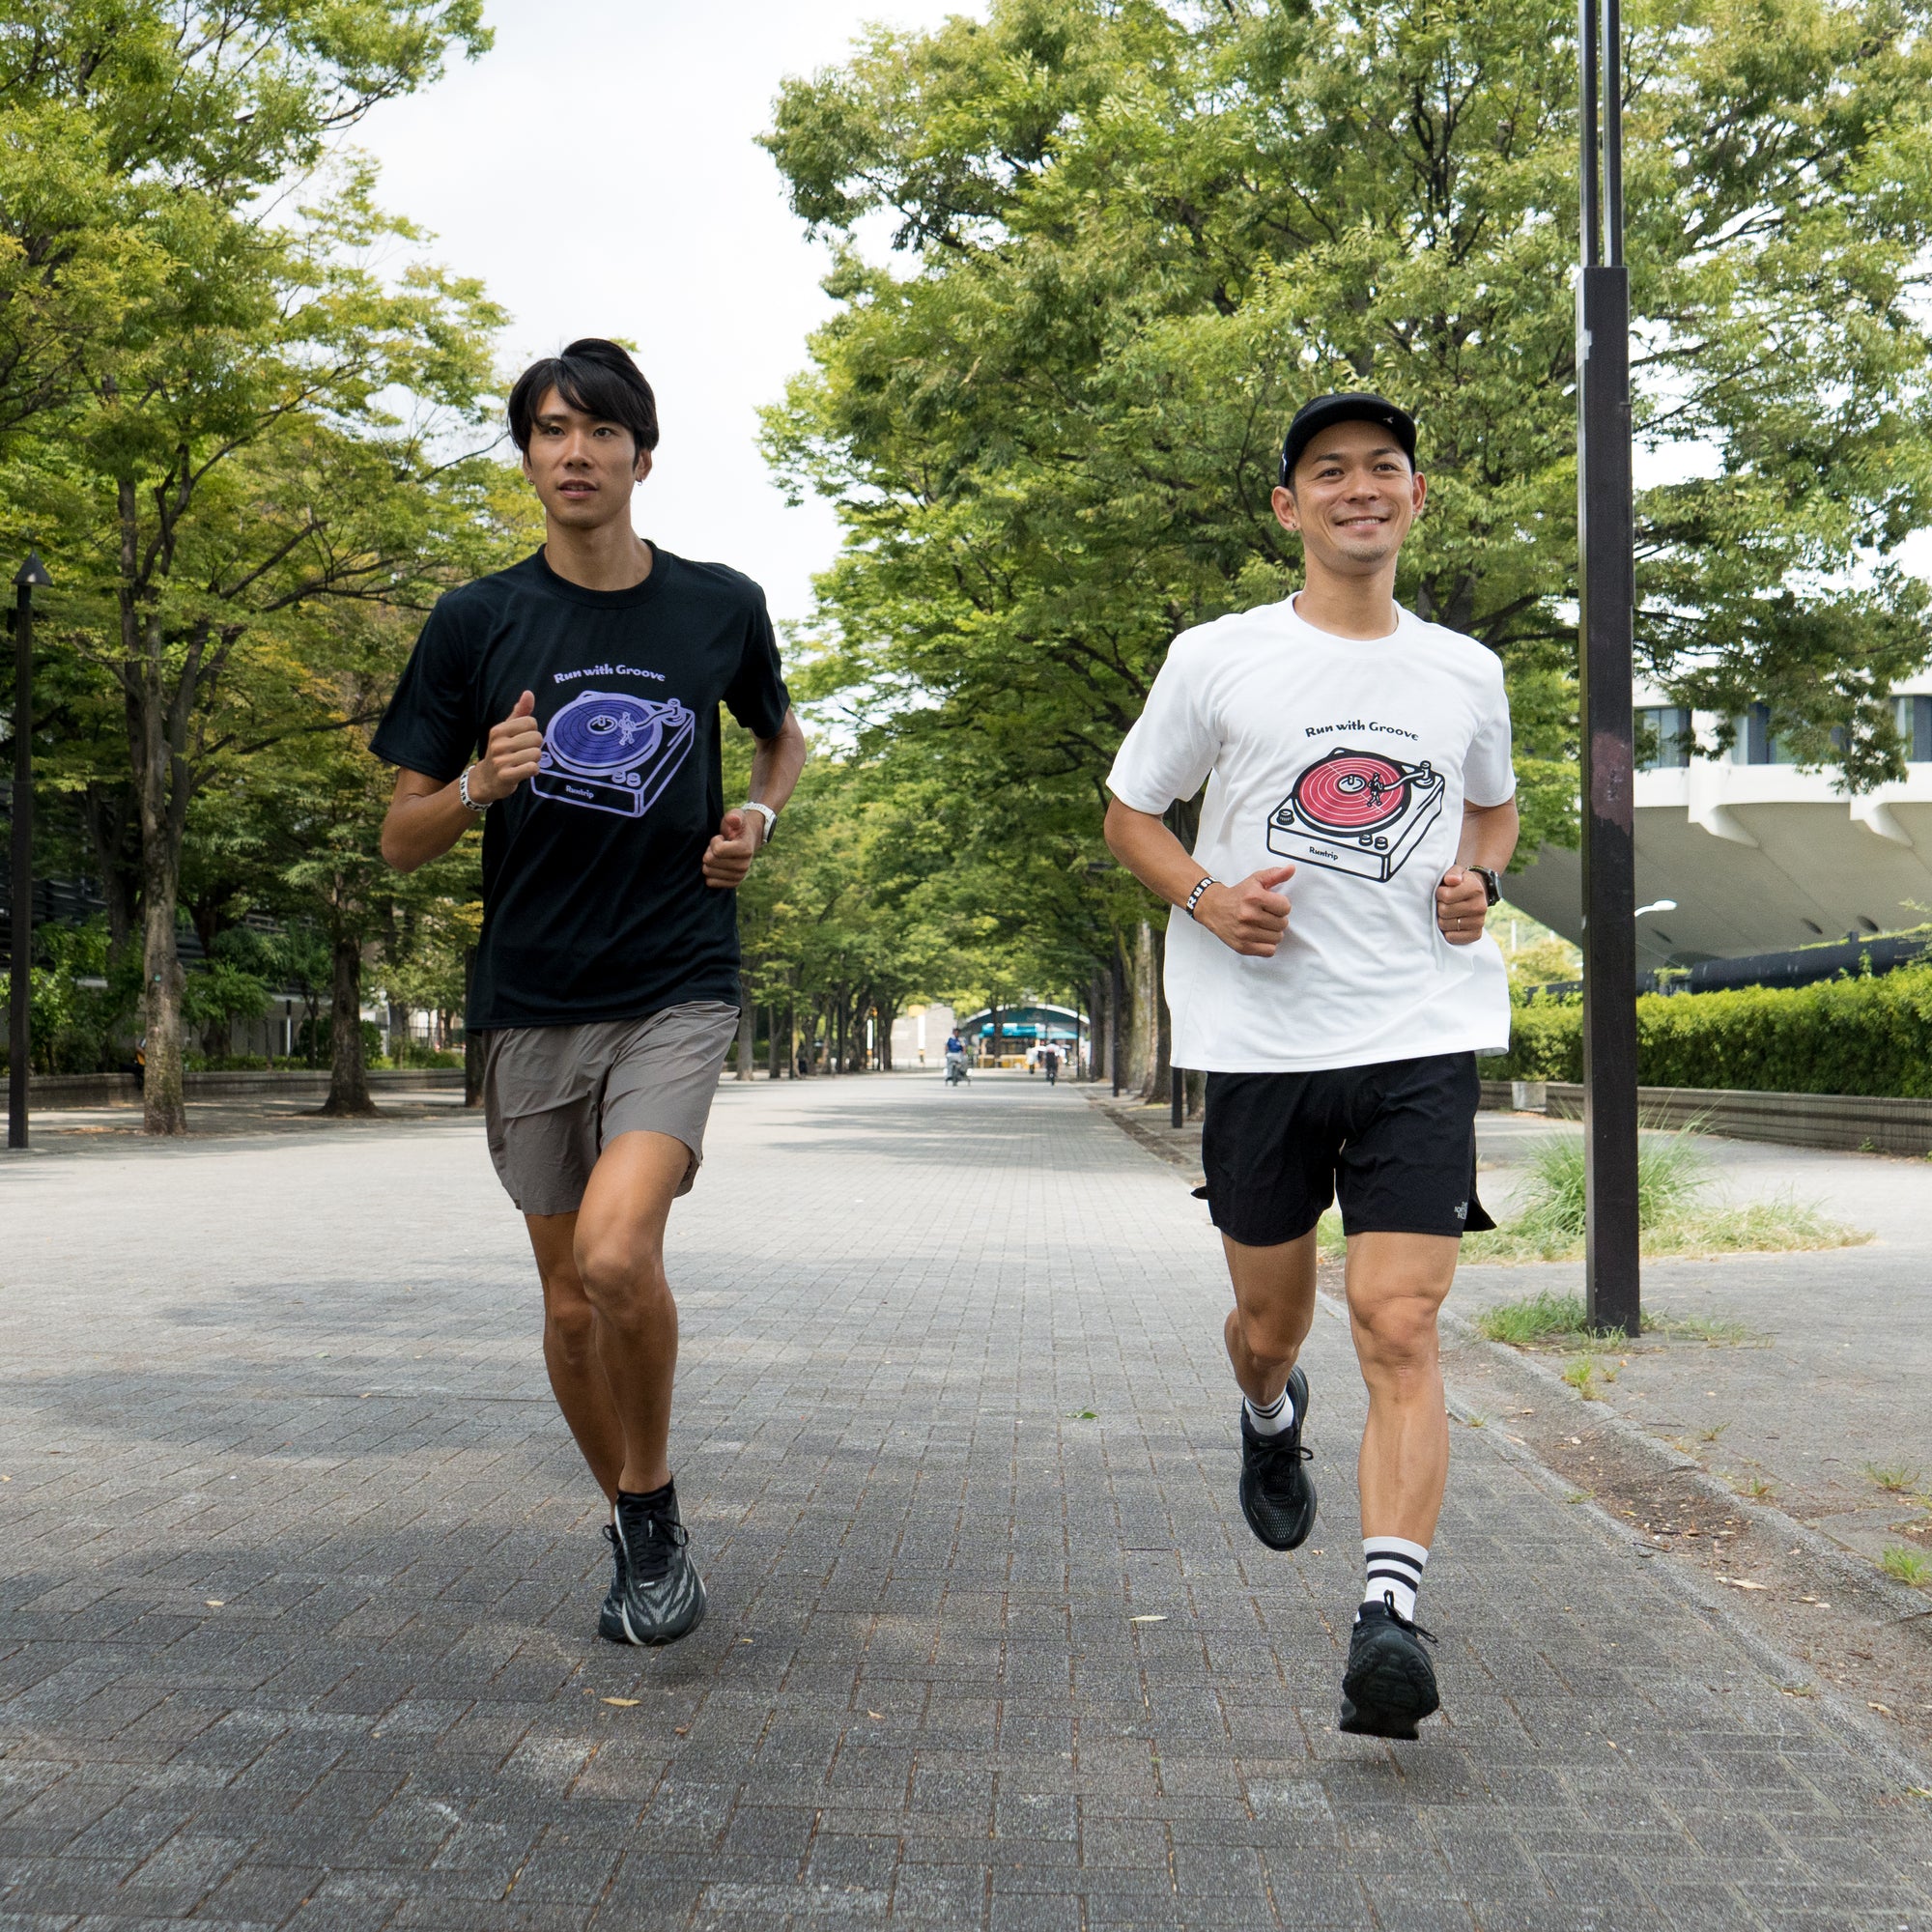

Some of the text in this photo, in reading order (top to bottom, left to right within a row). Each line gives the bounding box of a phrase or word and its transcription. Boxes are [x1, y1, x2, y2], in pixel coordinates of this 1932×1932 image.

[554, 664, 666, 684] Run with Groove
[1305, 720, 1419, 741] Run with Groove
[1309, 845, 1339, 861] Runtrip
